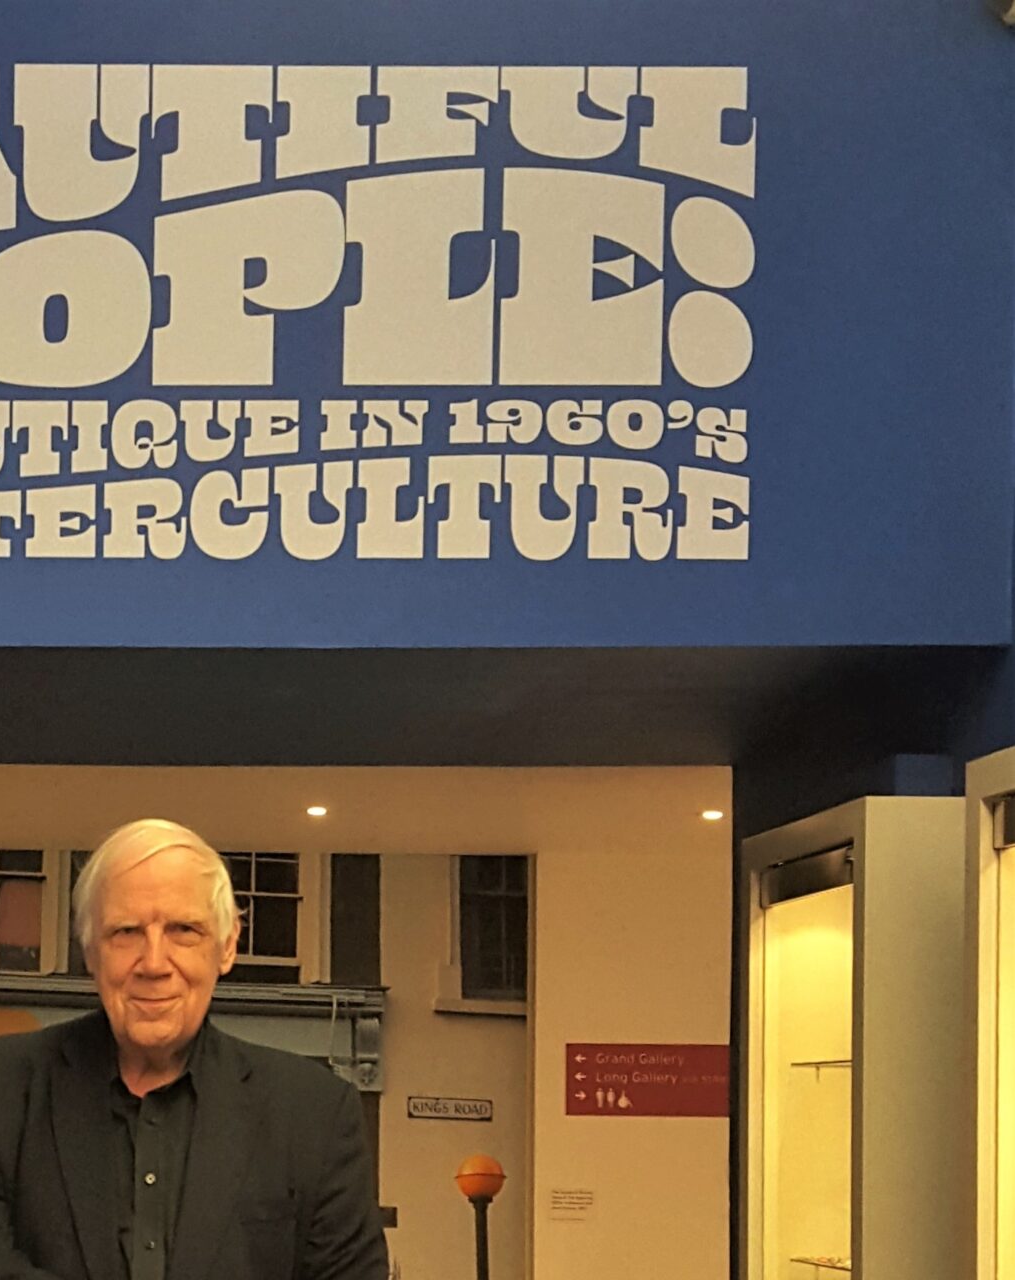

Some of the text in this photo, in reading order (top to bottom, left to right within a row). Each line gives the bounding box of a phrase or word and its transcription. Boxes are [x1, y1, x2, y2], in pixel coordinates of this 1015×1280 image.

[320, 399, 430, 453] IN
[449, 399, 748, 465] 1960'S
[595, 1052, 685, 1067] Grand Gallery
[595, 1071, 628, 1084] Long
[632, 1071, 678, 1085] Gallery
[412, 1101, 488, 1115] KINGS ROAD
